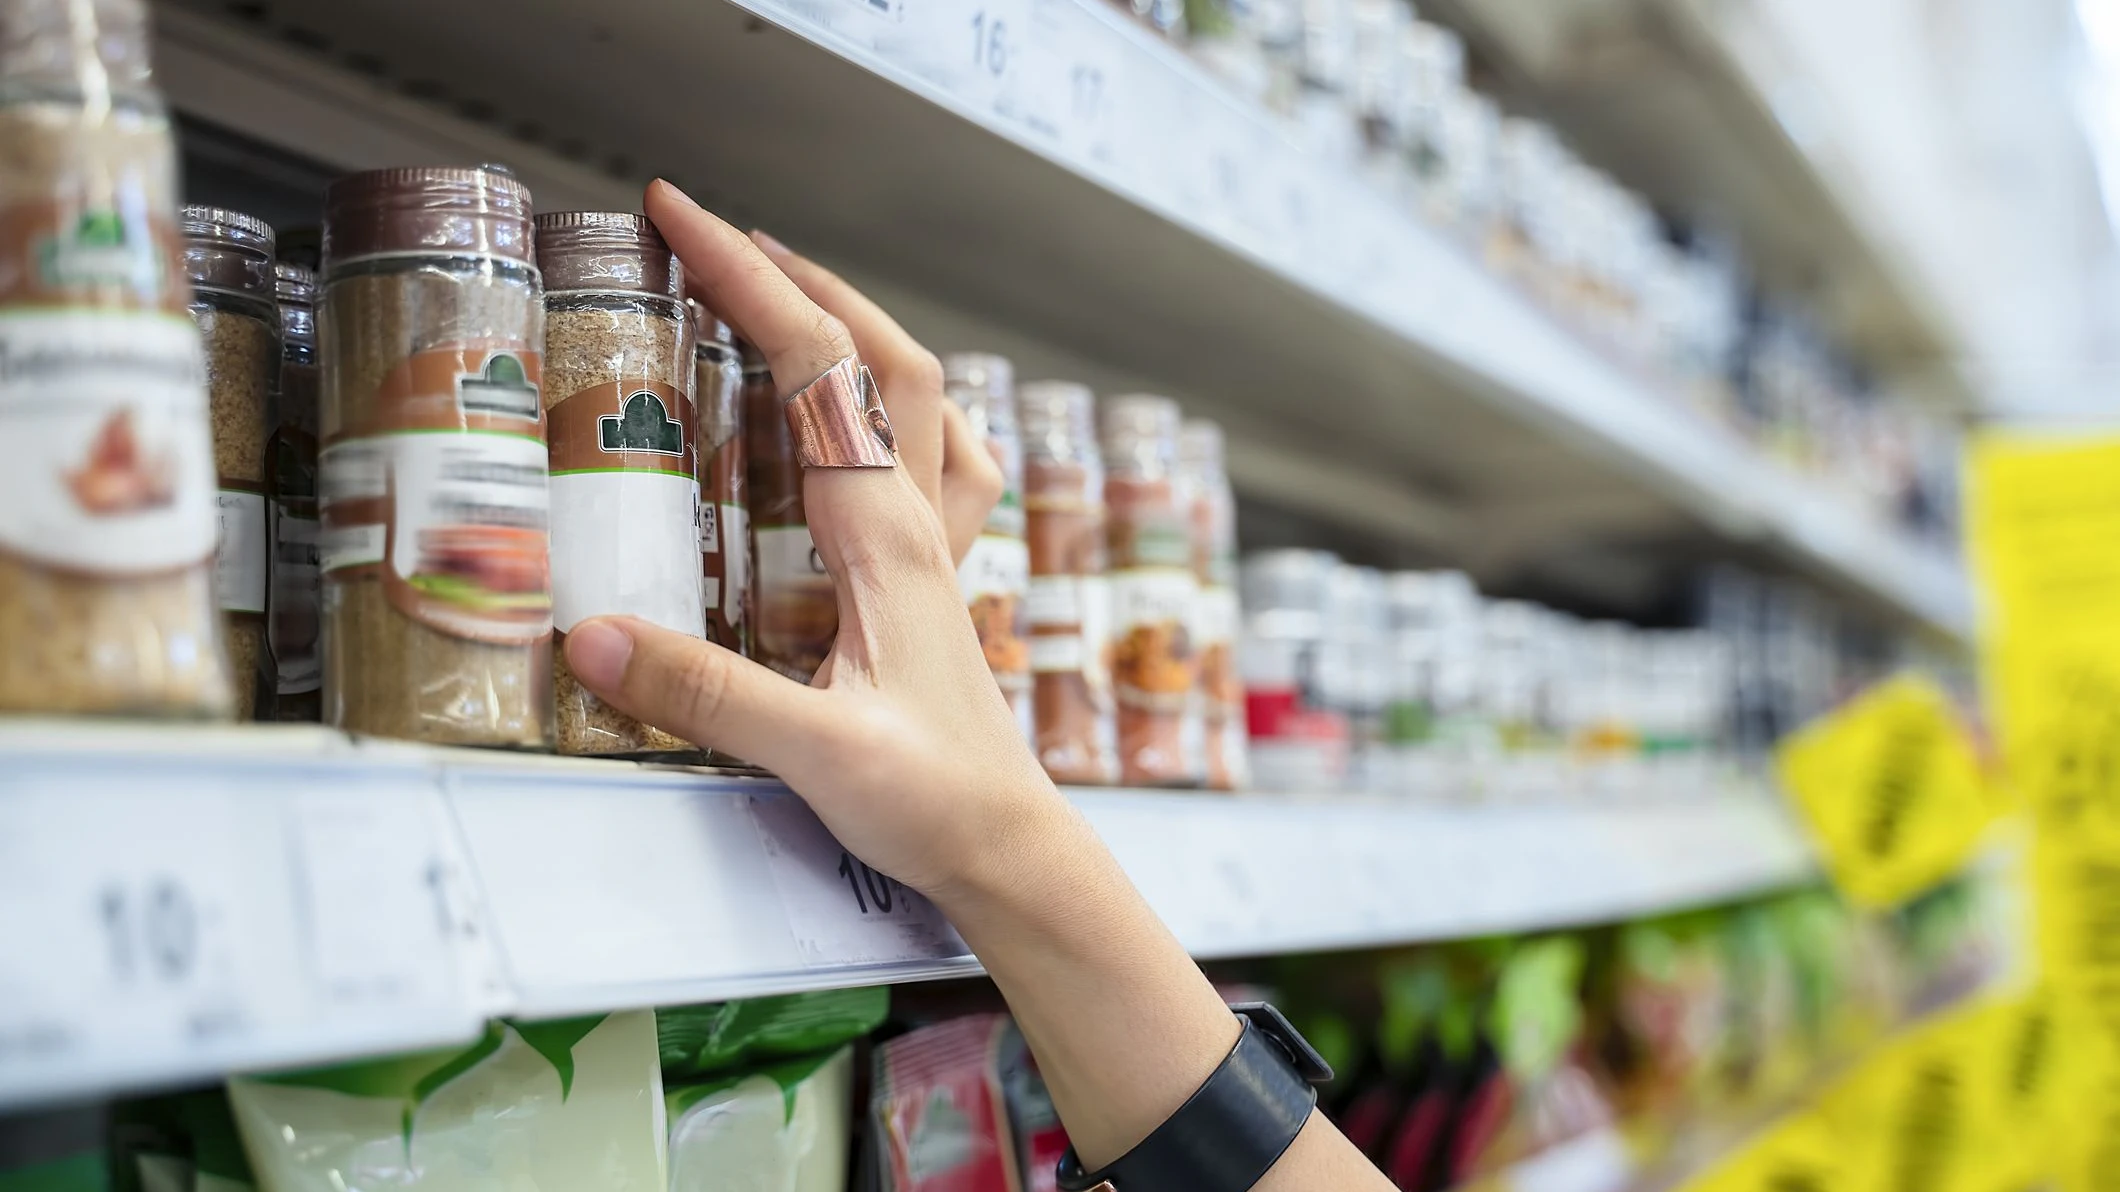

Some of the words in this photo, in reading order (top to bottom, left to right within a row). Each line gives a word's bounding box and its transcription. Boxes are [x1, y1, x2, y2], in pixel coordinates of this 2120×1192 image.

[971, 12, 1006, 77] 16
[838, 852, 892, 913] 10
[98, 877, 199, 986] 10
